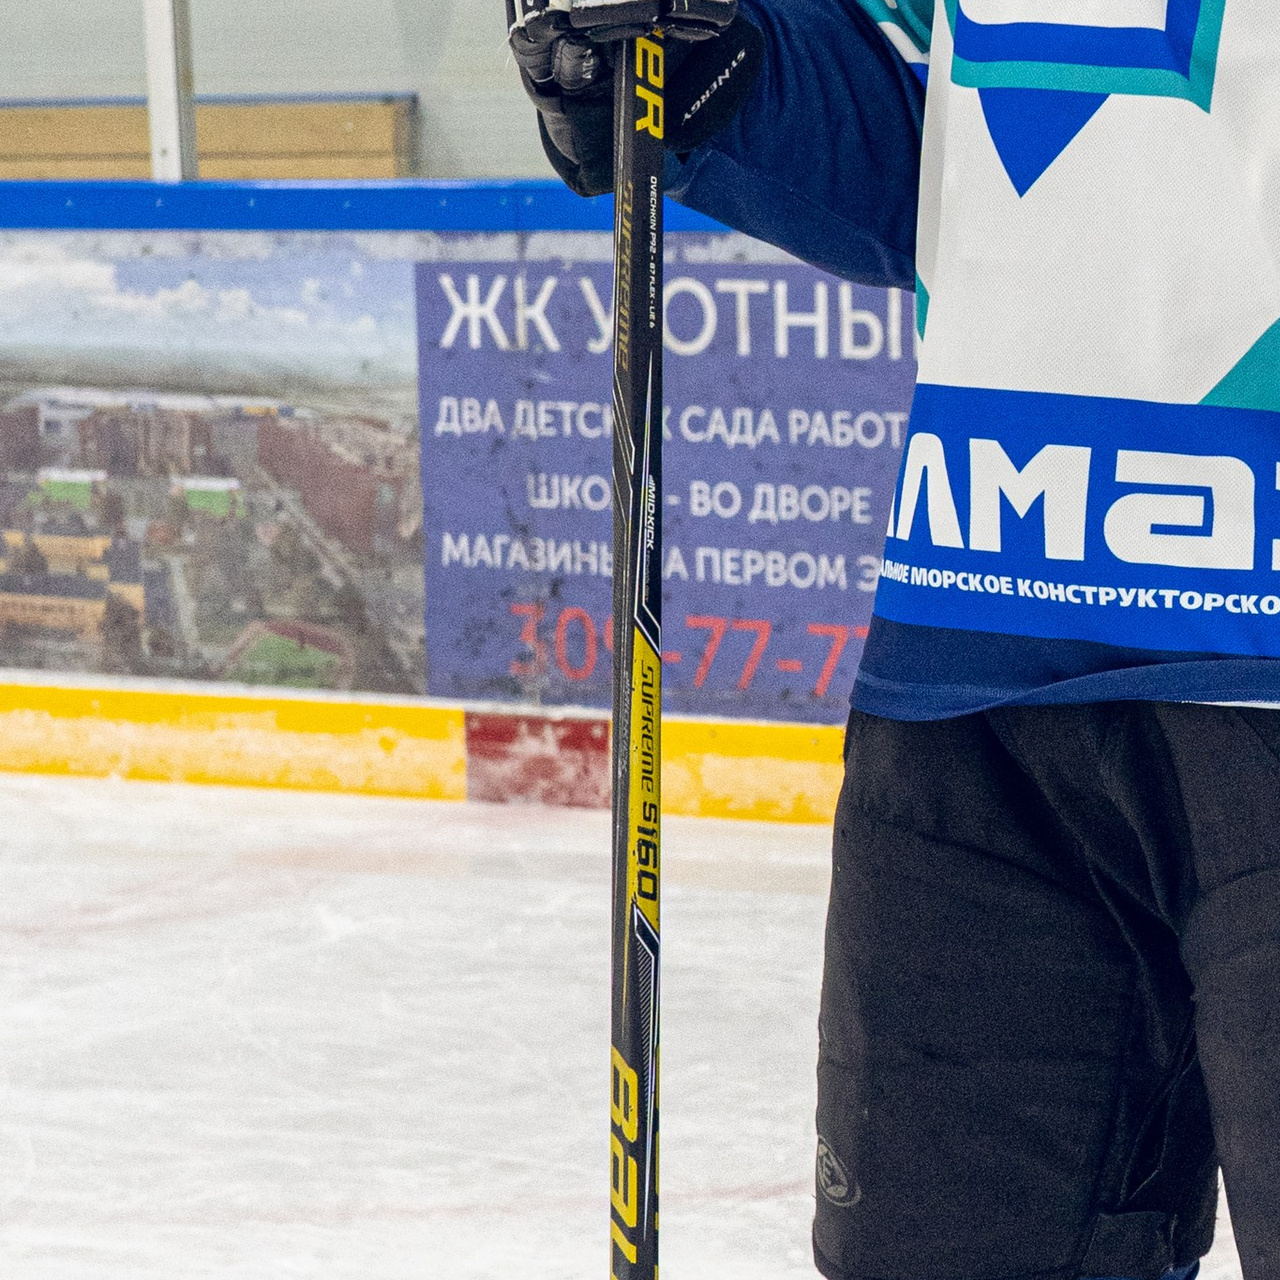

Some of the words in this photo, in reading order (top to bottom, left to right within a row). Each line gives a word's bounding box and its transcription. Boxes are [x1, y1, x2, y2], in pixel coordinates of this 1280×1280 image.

[648, 175, 658, 230] OVECHKIN
[648, 231, 658, 254] P92
[439, 274, 561, 351] ЖК
[436, 396, 500, 438] ДВА
[680, 405, 780, 449] САДА
[528, 473, 613, 511] ШКО
[690, 481, 741, 518] ВО
[747, 485, 873, 526] ДВОРЕ
[696, 547, 849, 589] ПЕРВОМ
[911, 566, 1014, 595] МОРСКОЕ
[641, 659, 654, 793] SUPREME
[636, 801, 658, 902] S160
